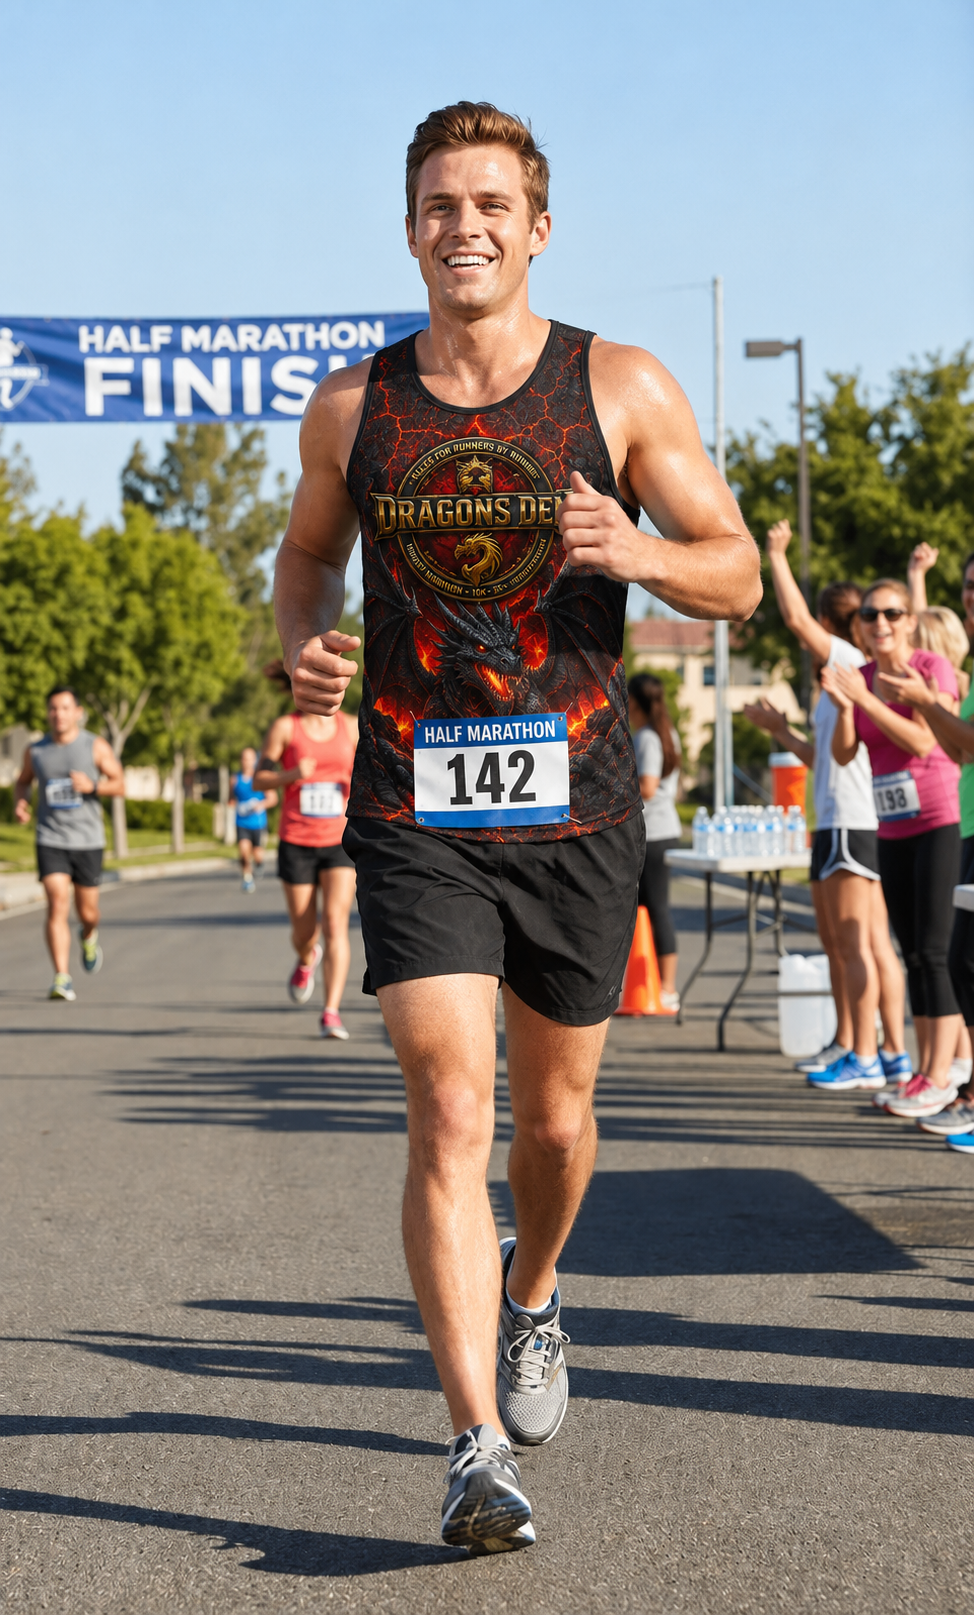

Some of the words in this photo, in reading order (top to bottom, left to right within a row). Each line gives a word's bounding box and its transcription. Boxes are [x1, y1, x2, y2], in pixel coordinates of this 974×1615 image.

[79, 325, 173, 354] HALF
[181, 320, 386, 353] MARATHON
[84, 353, 375, 417] FINIS
[375, 495, 512, 535] DRAGONS
[424, 725, 463, 744] HALF
[467, 720, 556, 742] MARATHON
[447, 749, 537, 806] 142
